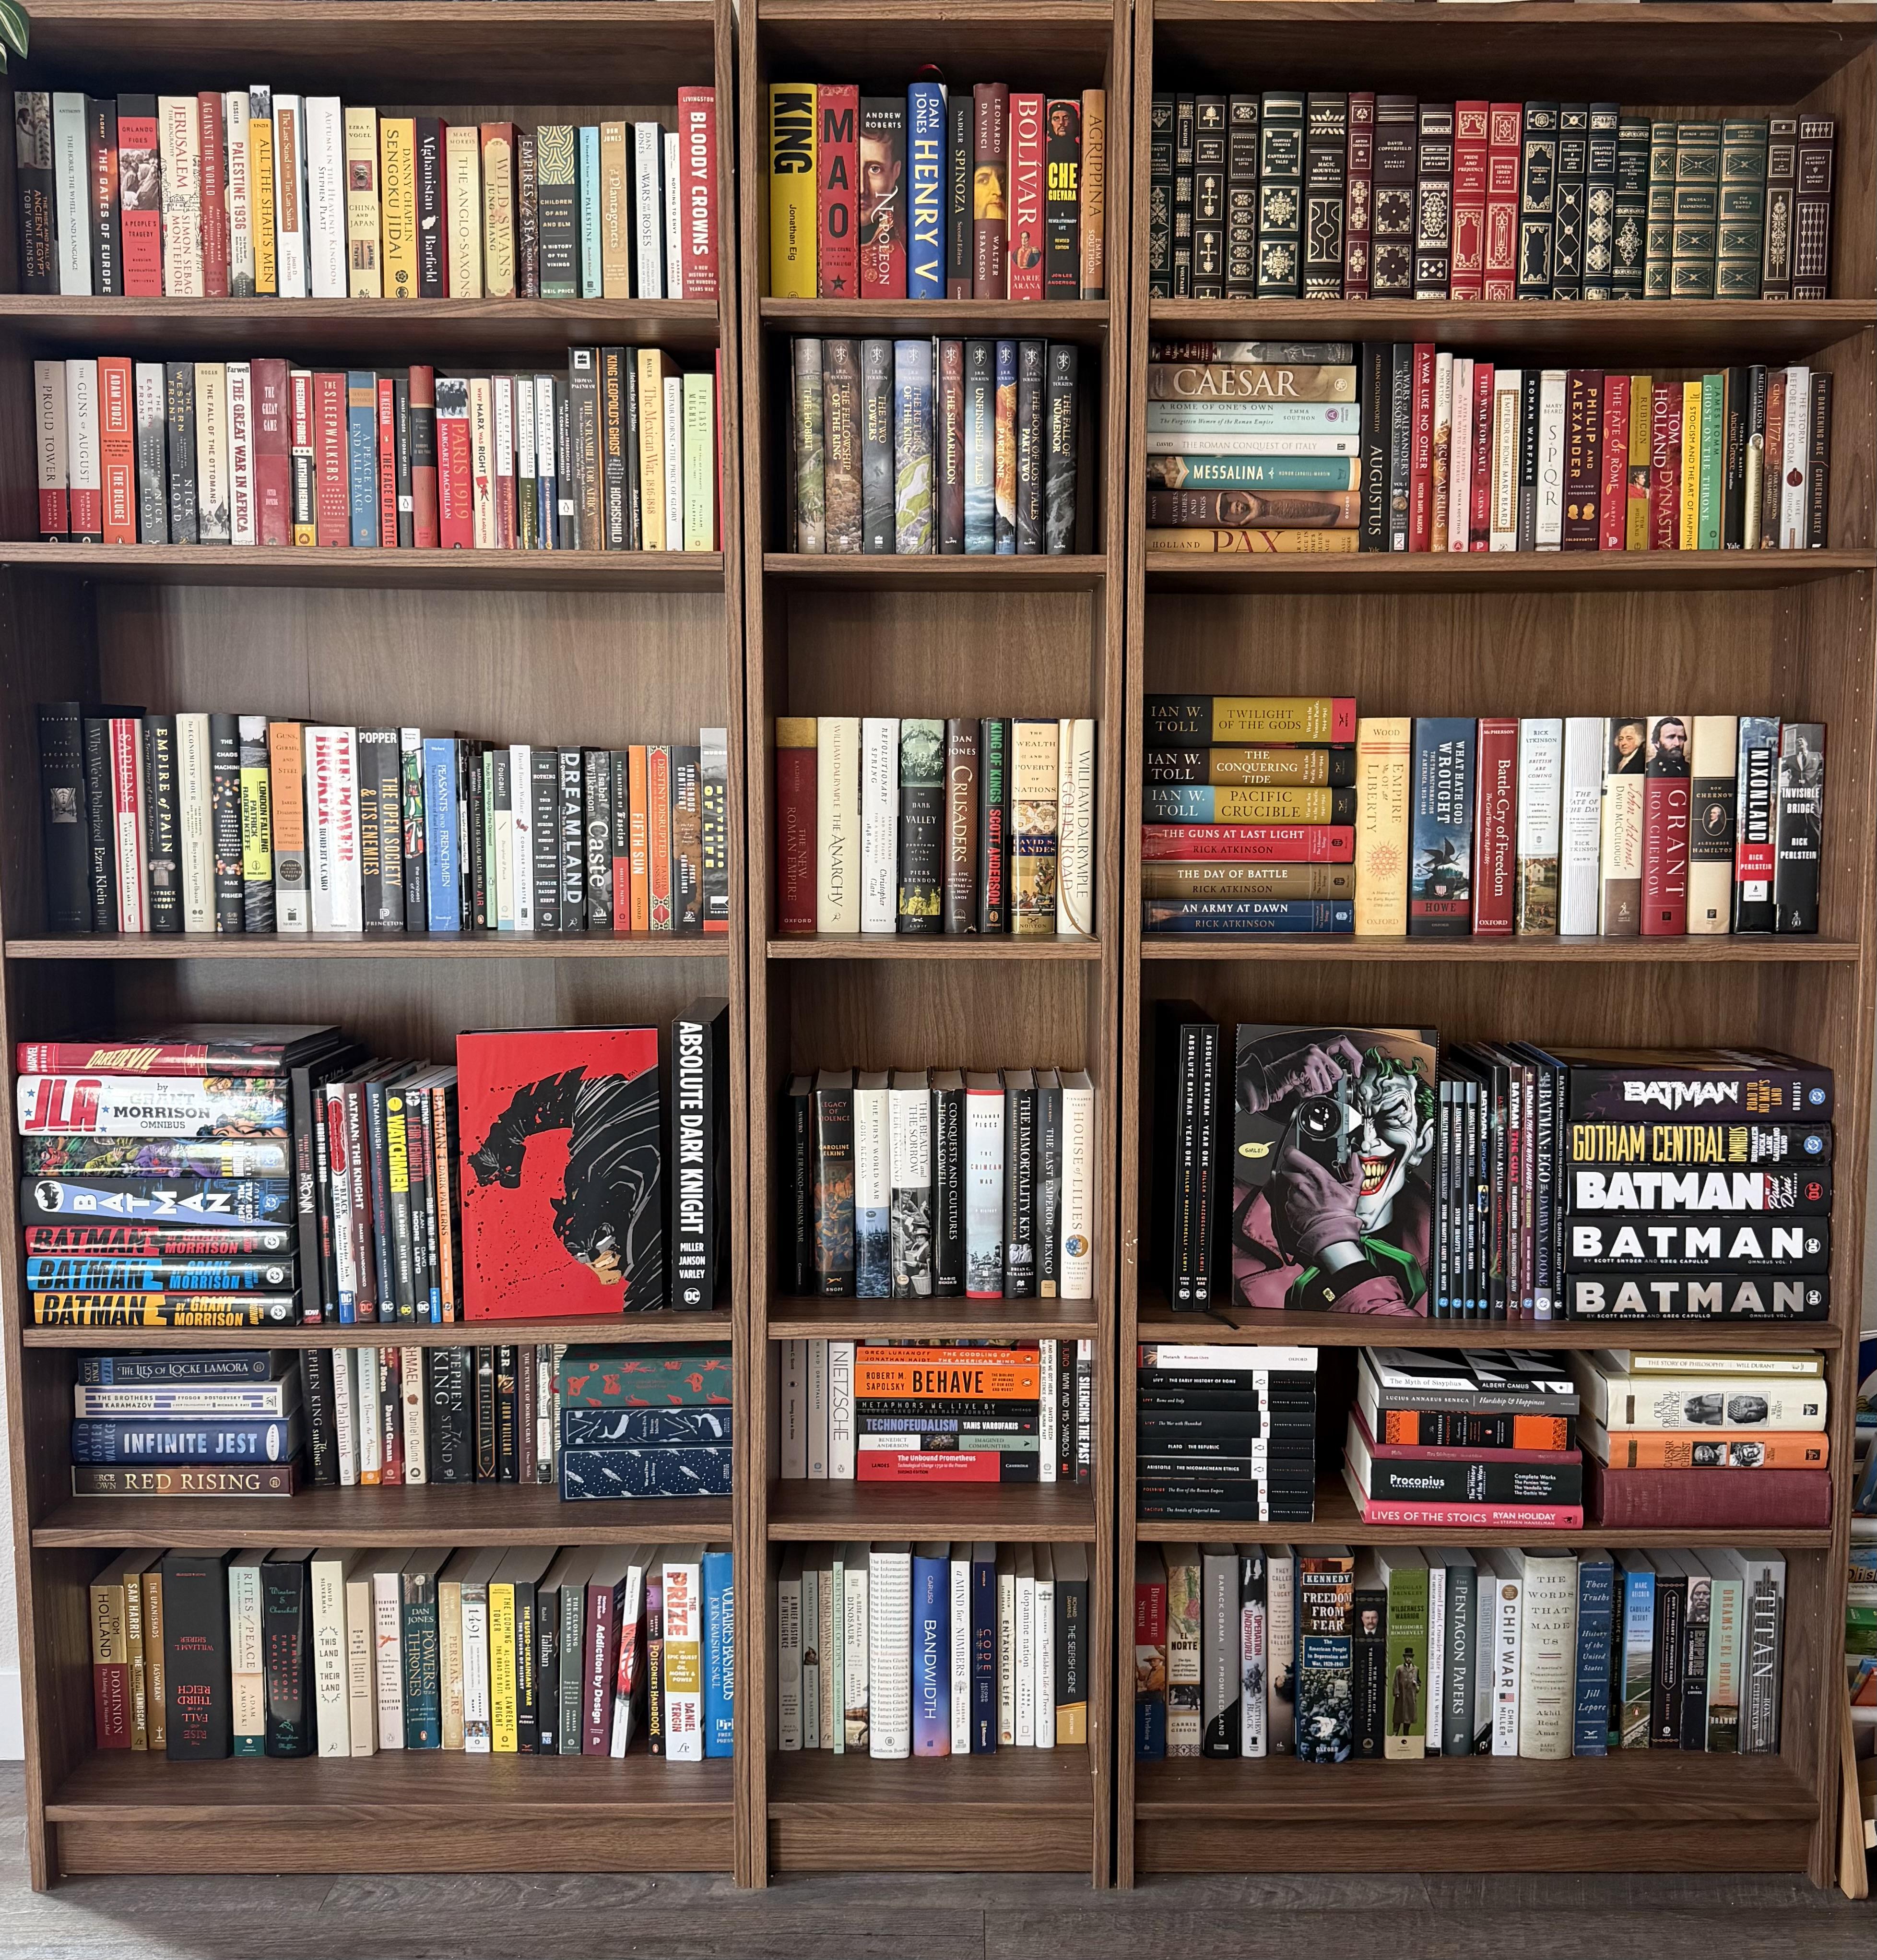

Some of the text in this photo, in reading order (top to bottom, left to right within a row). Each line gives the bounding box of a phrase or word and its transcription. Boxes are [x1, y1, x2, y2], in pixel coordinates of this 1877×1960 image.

[173, 105, 188, 189] JERUSALEM
[774, 94, 813, 174] KING
[690, 111, 709, 255] BLOODY CROWNS
[1017, 100, 1037, 226] BOLÍVAR
[1049, 163, 1077, 188] CHE
[1085, 115, 1102, 216] AGRIPPINA
[387, 130, 402, 260] SENGOKU JIDAI
[915, 140, 939, 282] HENRY V
[1049, 190, 1076, 201] GUEVARA
[99, 148, 111, 293] THE GATES OF EUROPE
[788, 205, 796, 244] Jonathan
[1173, 370, 1300, 396] CAESAR
[324, 390, 338, 482] SLEEPWALKERS
[451, 423, 469, 519] PARIS 1919
[1193, 466, 1263, 480] MESSALINA
[1369, 445, 1382, 536] AUGUSTUS
[112, 471, 125, 520] THE DELUGE
[611, 487, 623, 543] HOCHSCHILD
[1152, 707, 1203, 717] IAN W.
[1156, 722, 1198, 732] TOLL
[1219, 721, 1301, 729] OF THE GODS
[1228, 710, 1293, 718] TWILIGHT
[359, 733, 397, 743] POPPER
[948, 748, 976, 757] JONES
[156, 728, 172, 853] EMPIRE of PAIN
[1749, 750, 1769, 841] NIXONLAND
[566, 753, 582, 903] DREAMLAND
[951, 766, 972, 863] CRUSADERS
[588, 821, 608, 888] Caste
[632, 813, 645, 875] FIFTH SUN
[1666, 790, 1687, 897] GRANT
[1253, 904, 1288, 913] DAWN
[1425, 903, 1456, 912] HOWE
[25, 1079, 102, 1132] JLA
[157, 1083, 168, 1093] by
[1623, 1081, 1739, 1111] BATMAN
[114, 1107, 210, 1118] MORRISON
[680, 1022, 704, 1234] ABSOLUTE DARK KNIGHT
[388, 1116, 409, 1192] WATCHMEN
[1074, 1112, 1084, 1164] HOUSE
[1573, 1125, 1725, 1162] GOTHAM CENTRAL
[1072, 1180, 1083, 1231] LILIES
[1576, 1172, 1763, 1210] BATMAN
[680, 1243, 704, 1252] MILLER
[1573, 1227, 1803, 1258] BATMAN
[679, 1269, 705, 1279] VARLEY
[42, 1295, 148, 1325] BATMAN
[1576, 1281, 1804, 1312] BATMAN
[833, 1351, 848, 1440] NIETZSCHE
[866, 1382, 905, 1391] SAPOLSKY
[913, 1371, 984, 1392] BEHAVE
[124, 1433, 257, 1453] INFINITE JEST
[866, 1418, 957, 1431] TECHNOFEUDALISM
[125, 1474, 261, 1490] RED RISING
[1391, 1475, 1444, 1487] Procopius
[1371, 1512, 1399, 1520] LIVES
[1423, 1512, 1443, 1520] THE
[1447, 1513, 1486, 1522] STOICS
[128, 1583, 139, 1639] SAM HARRIS
[667, 1572, 687, 1636] PRIZE
[1303, 1592, 1352, 1603] FREEDOM
[1312, 1606, 1344, 1616] FROM
[1313, 1620, 1343, 1630] FEAR
[1501, 1605, 1515, 1688] CHIP WAR
[1753, 1590, 1775, 1679] TITAN
[593, 1625, 605, 1724] Addiction by Design
[924, 1620, 936, 1719] BANDWIDTH
[112, 1670, 122, 1734] DOMINION
